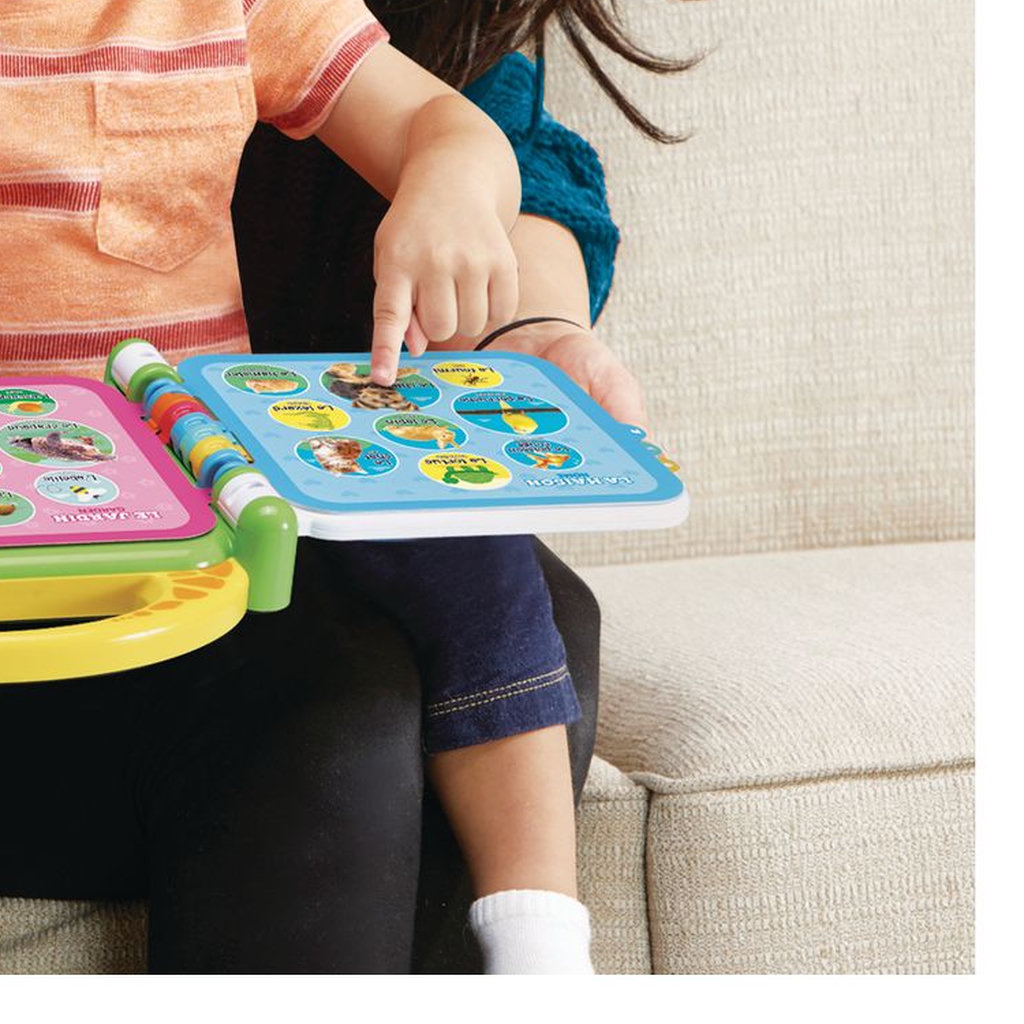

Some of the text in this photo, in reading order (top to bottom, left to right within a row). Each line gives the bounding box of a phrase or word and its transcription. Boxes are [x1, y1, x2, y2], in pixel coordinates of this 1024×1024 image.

[424, 458, 468, 466] tortue
[525, 477, 602, 488] MAISON
[51, 511, 161, 523] LE JARDIN
